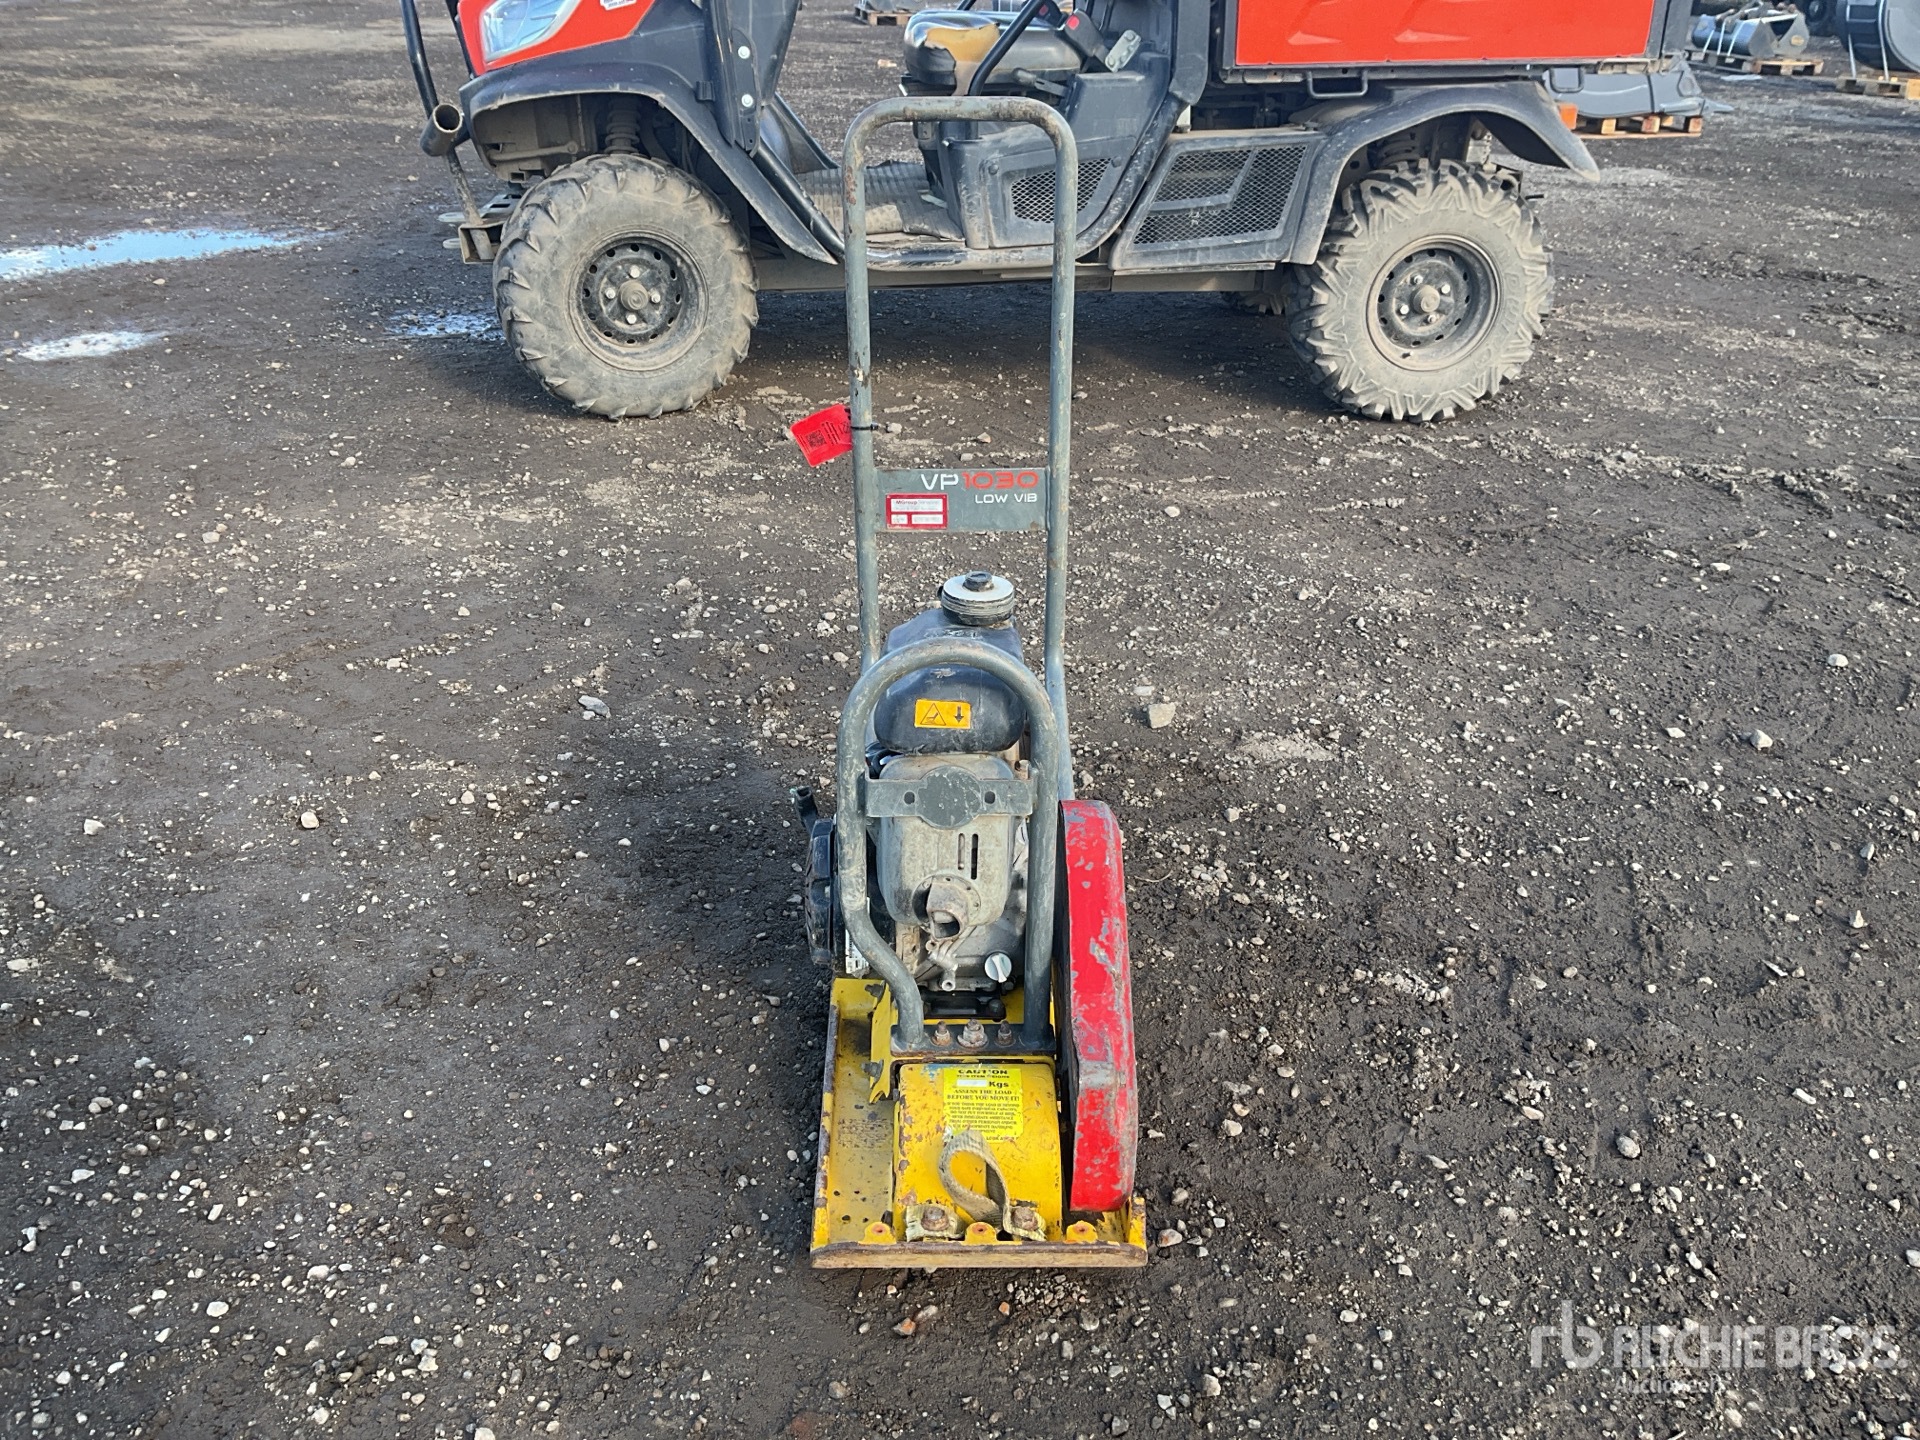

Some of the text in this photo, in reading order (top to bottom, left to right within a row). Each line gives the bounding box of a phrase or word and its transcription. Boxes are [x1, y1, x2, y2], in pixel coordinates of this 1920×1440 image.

[921, 471, 1039, 490] VP1030
[975, 493, 1038, 503] LOW VIB
